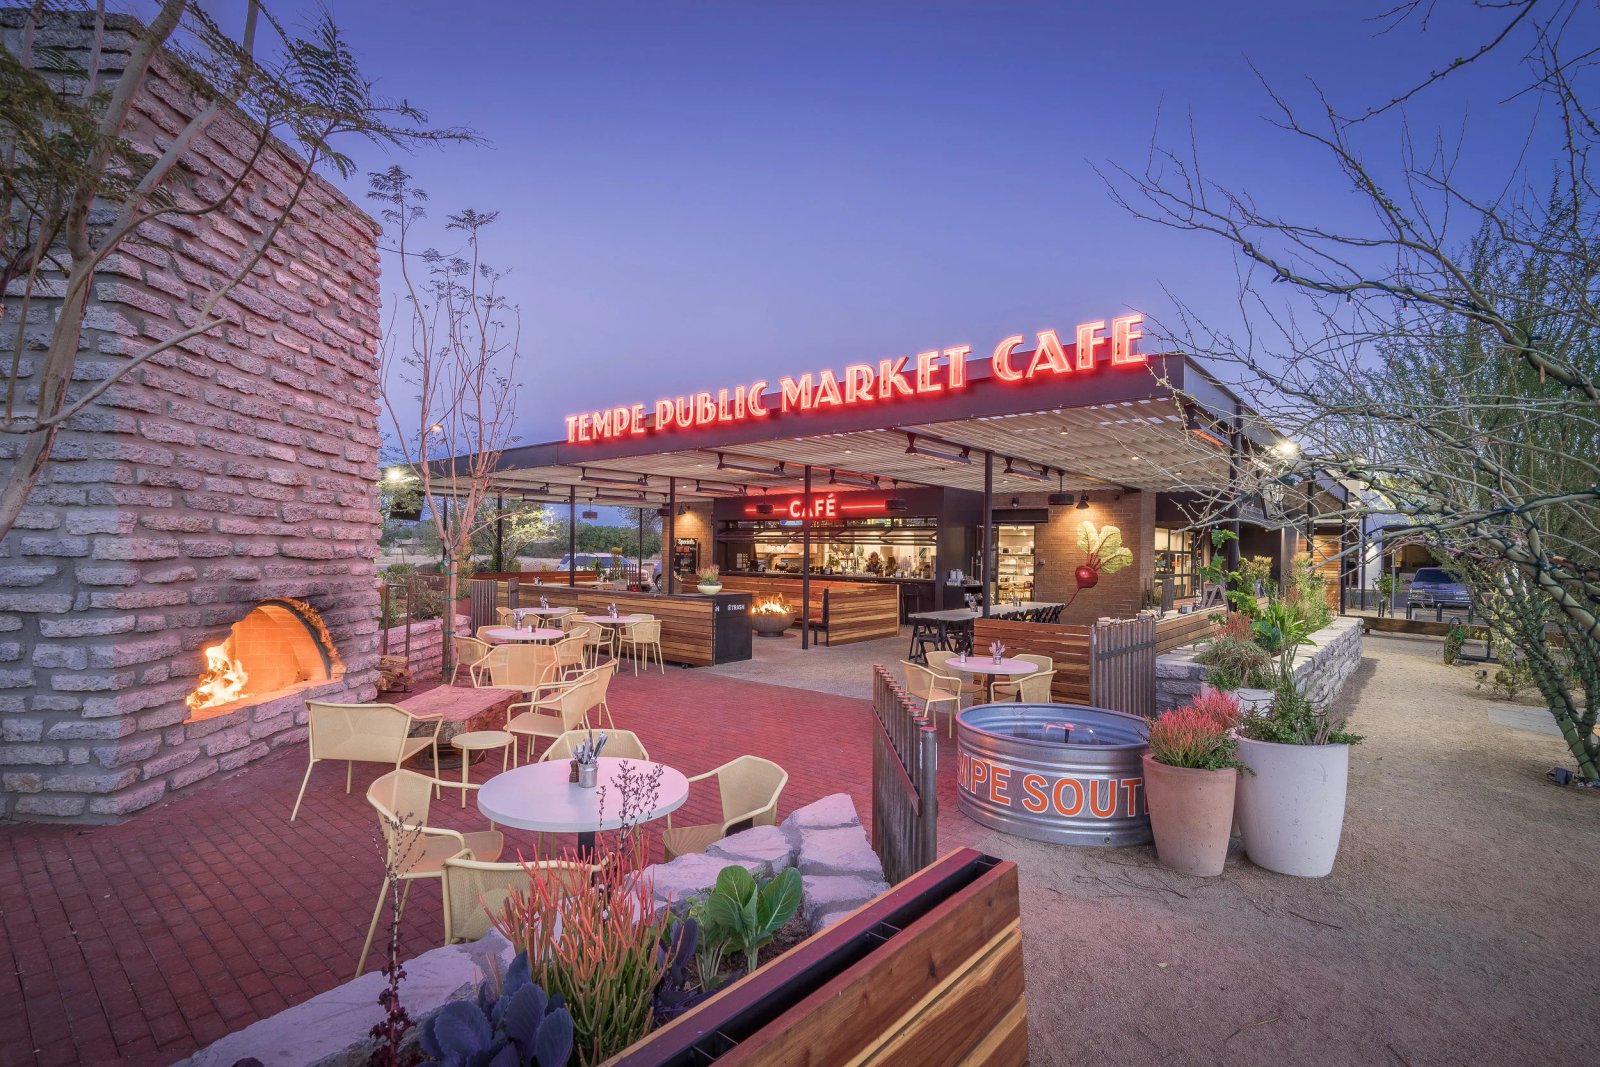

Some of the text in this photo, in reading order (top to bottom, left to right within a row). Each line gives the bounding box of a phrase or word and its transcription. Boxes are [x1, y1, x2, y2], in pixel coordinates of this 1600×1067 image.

[565, 313, 1148, 443] TEMPE PUBLIC MARKET CAFE
[958, 749, 1150, 819] MPE SOUT
